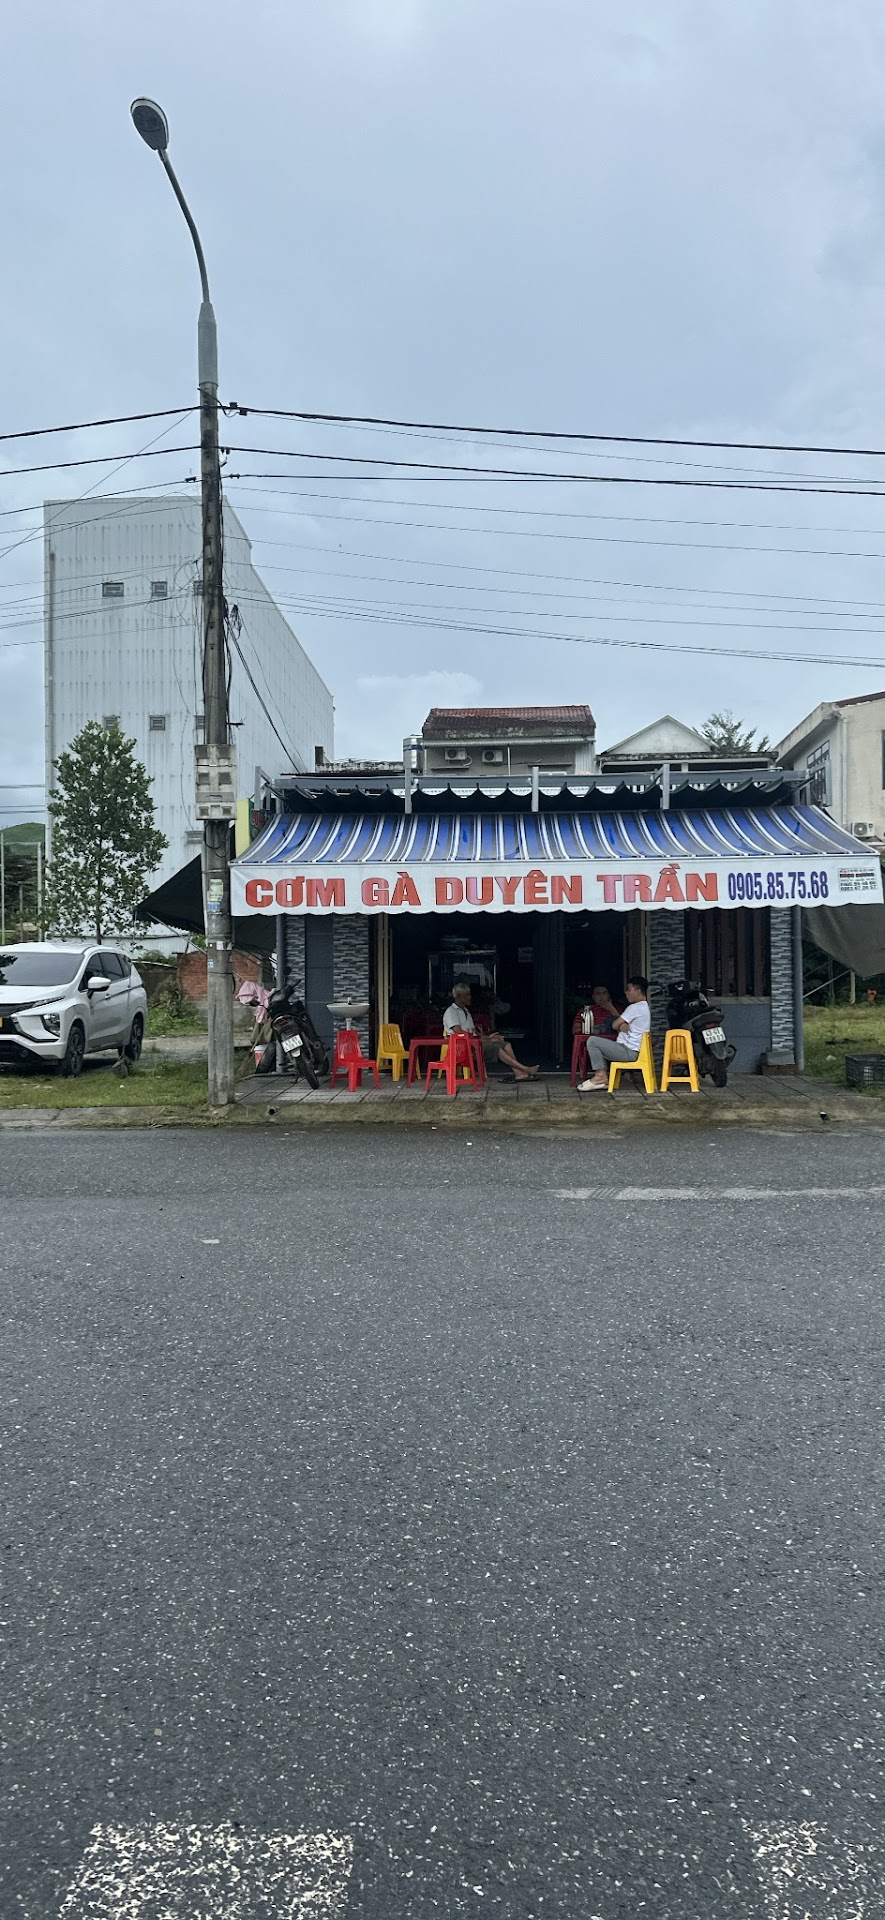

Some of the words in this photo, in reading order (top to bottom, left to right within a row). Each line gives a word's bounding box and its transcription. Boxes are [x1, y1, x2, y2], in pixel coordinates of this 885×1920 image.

[245, 875, 346, 908] CƠM
[361, 871, 421, 906] GÀ
[435, 869, 583, 905] DUYÊN
[597, 863, 719, 902] TRẦN
[727, 870, 829, 901] 0905.85.75.68
